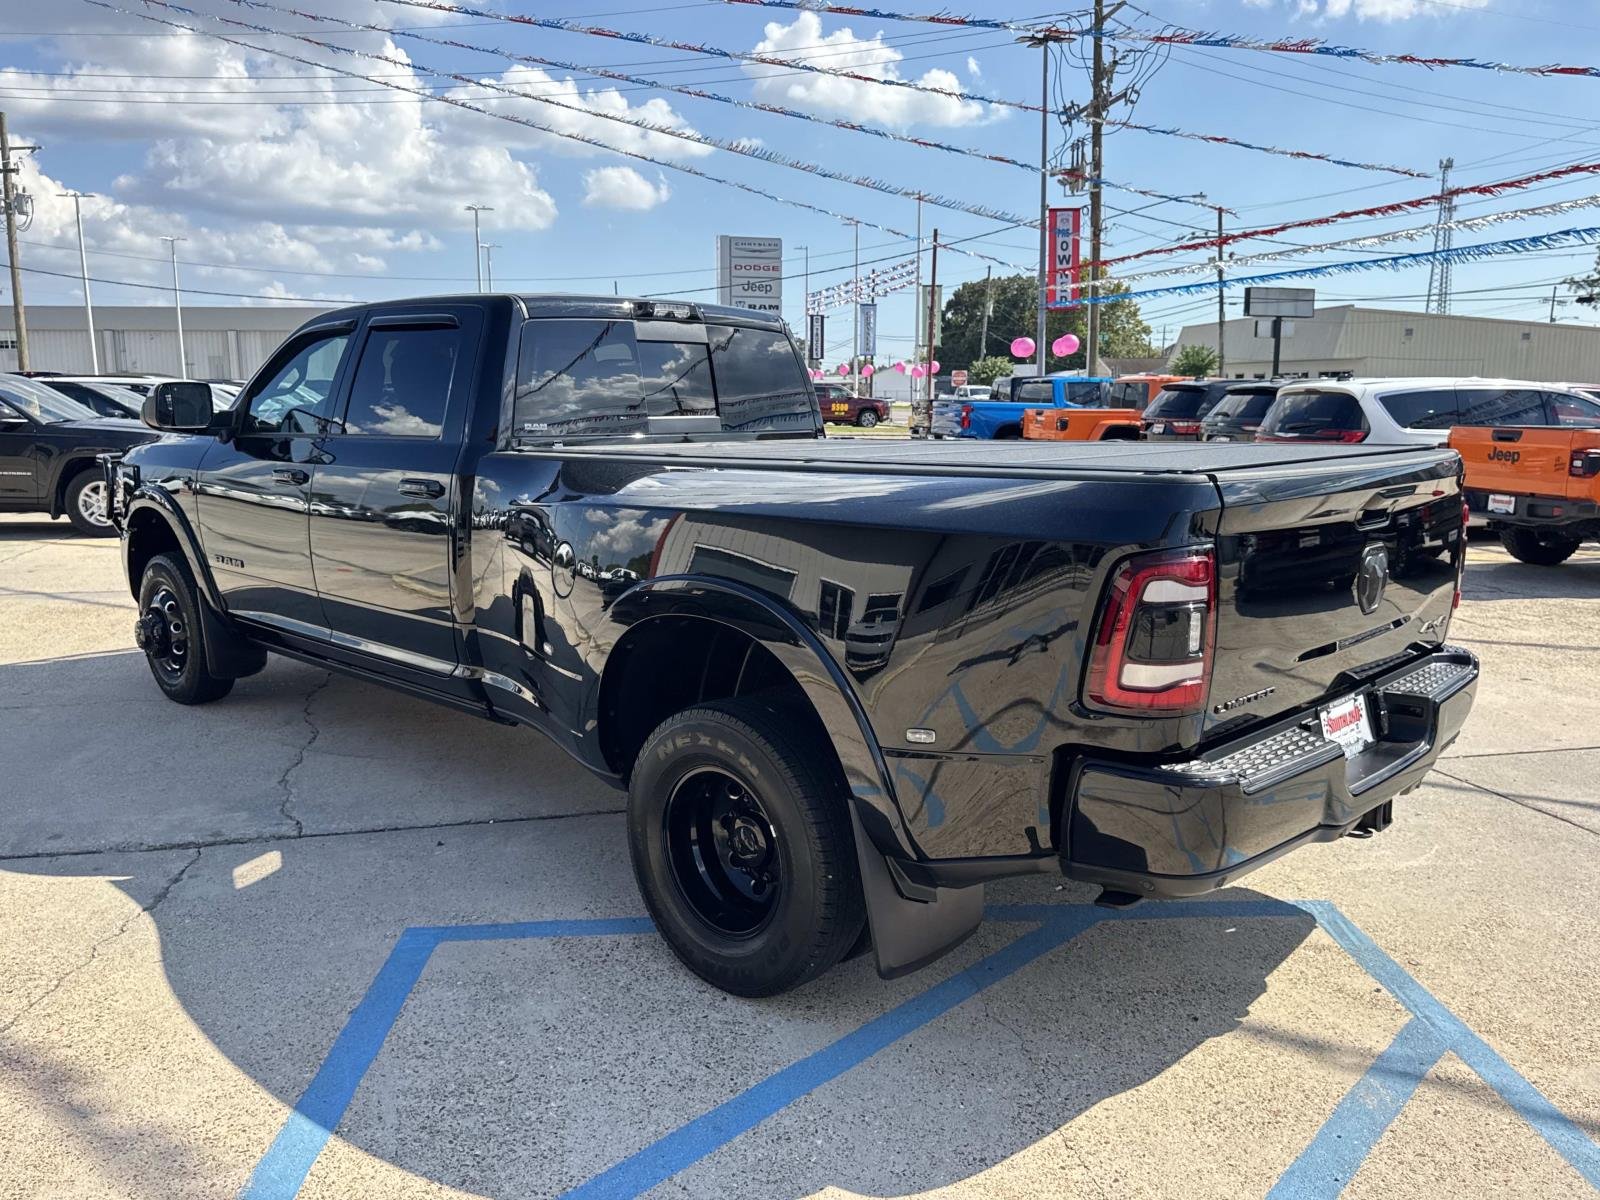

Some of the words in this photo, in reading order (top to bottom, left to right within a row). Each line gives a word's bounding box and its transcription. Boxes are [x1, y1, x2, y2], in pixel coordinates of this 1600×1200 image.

[734, 264, 780, 272] DODGE
[742, 280, 773, 294] Jeep
[747, 303, 780, 311] RAM
[524, 423, 548, 431] RAM
[1487, 446, 1521, 465] Jeep
[214, 554, 245, 569] RAM
